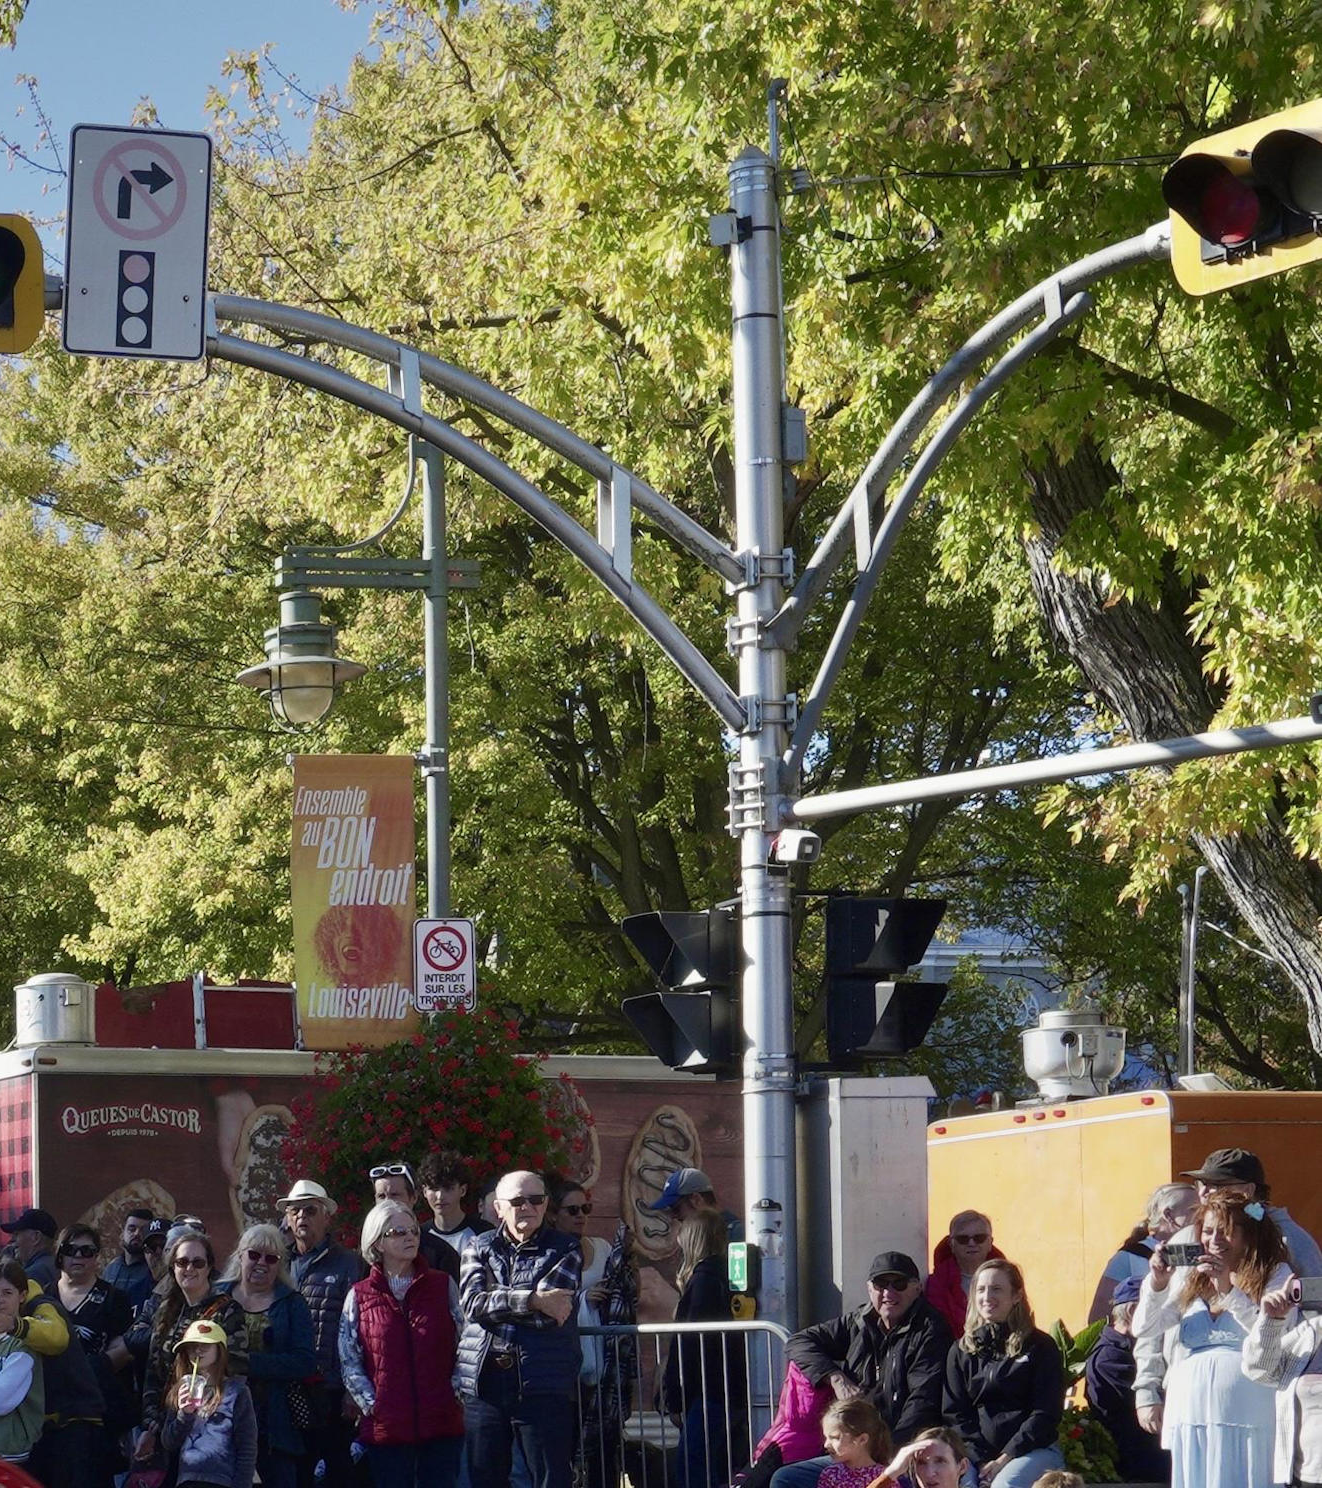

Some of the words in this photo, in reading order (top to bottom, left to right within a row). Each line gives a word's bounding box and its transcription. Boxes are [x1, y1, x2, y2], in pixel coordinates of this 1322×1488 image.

[294, 786, 367, 815] Ensemble
[301, 821, 322, 847] au
[317, 816, 377, 869] BON
[329, 863, 413, 906] endroit
[424, 973, 466, 983] INTERDIT
[425, 984, 445, 994] SUR
[448, 984, 466, 994] LES
[308, 981, 410, 1020] Louiseville
[61, 1105, 128, 1134] QUEUES
[140, 1103, 202, 1134] CASTOR
[111, 1128, 138, 1137] DEPUIS
